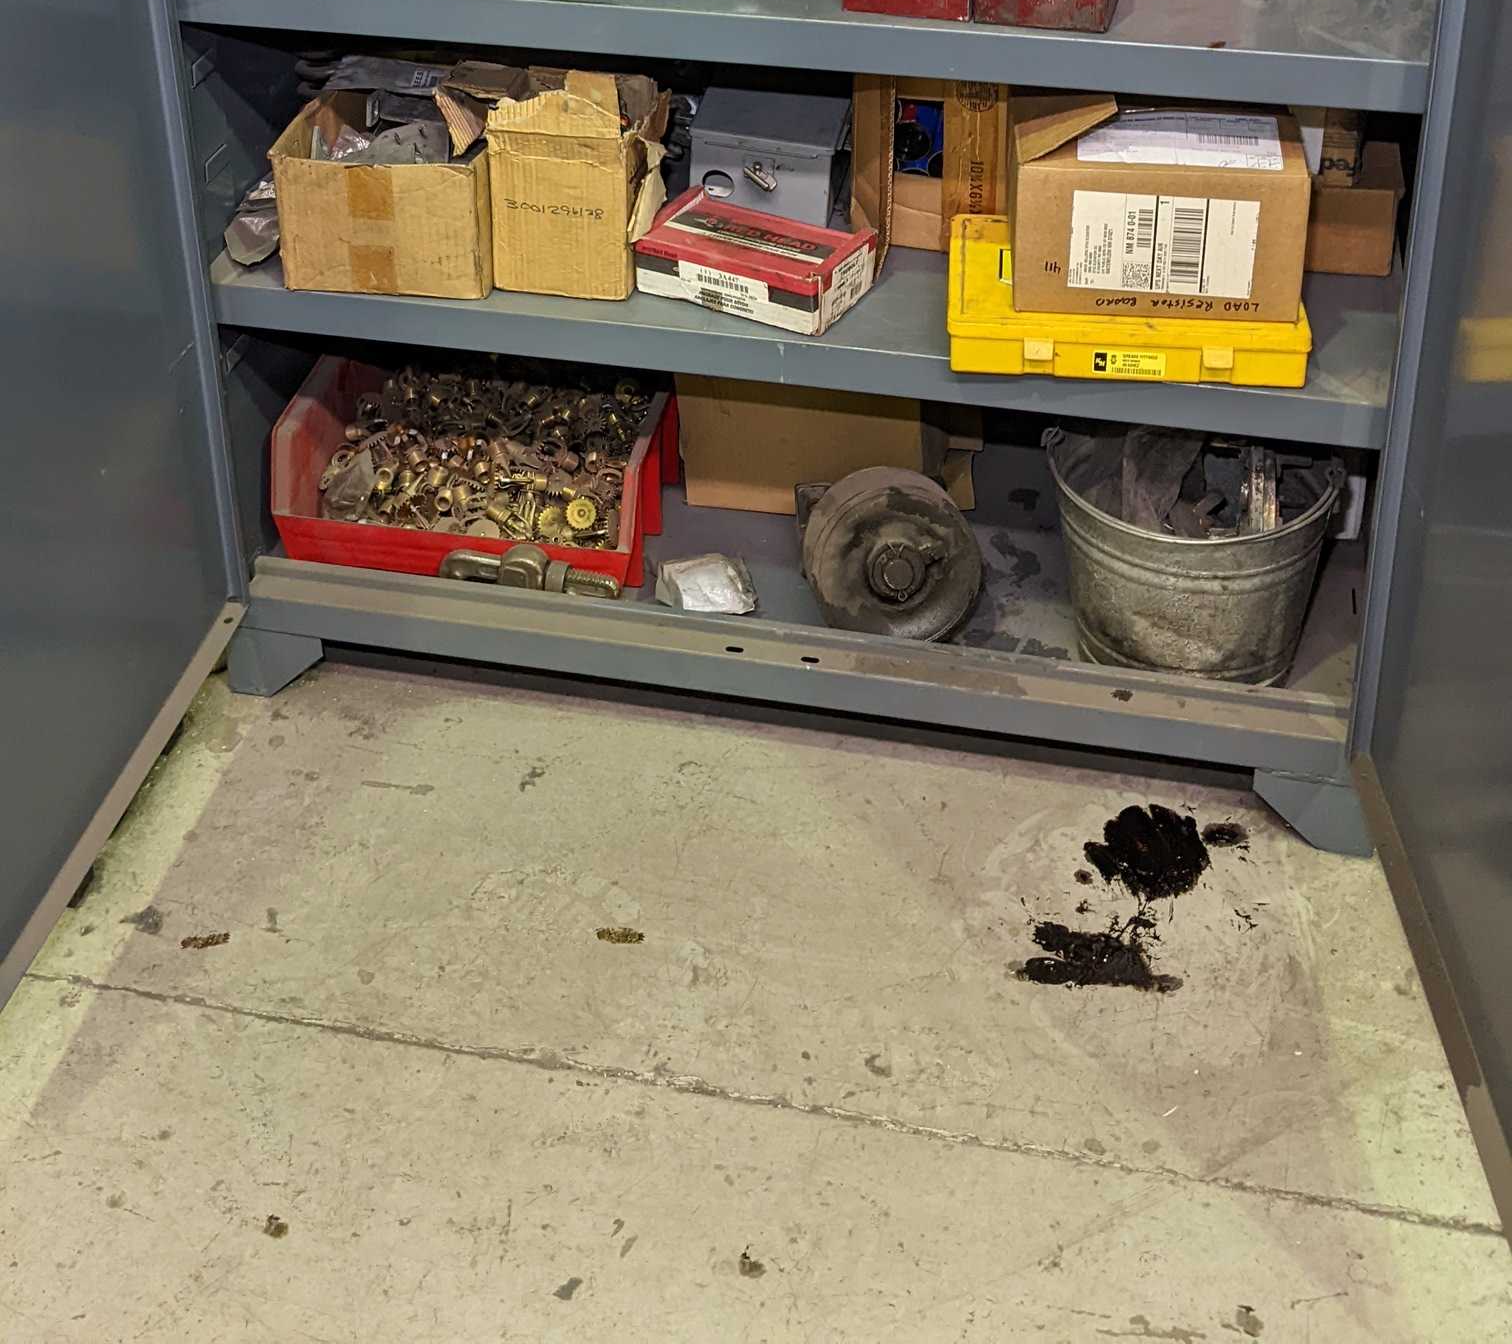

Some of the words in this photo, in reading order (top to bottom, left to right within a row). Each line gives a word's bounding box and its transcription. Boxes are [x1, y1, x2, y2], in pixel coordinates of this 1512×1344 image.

[765, 231, 818, 251] HEAD
[1126, 243, 1135, 254] NM
[1223, 301, 1260, 312] LOAD
